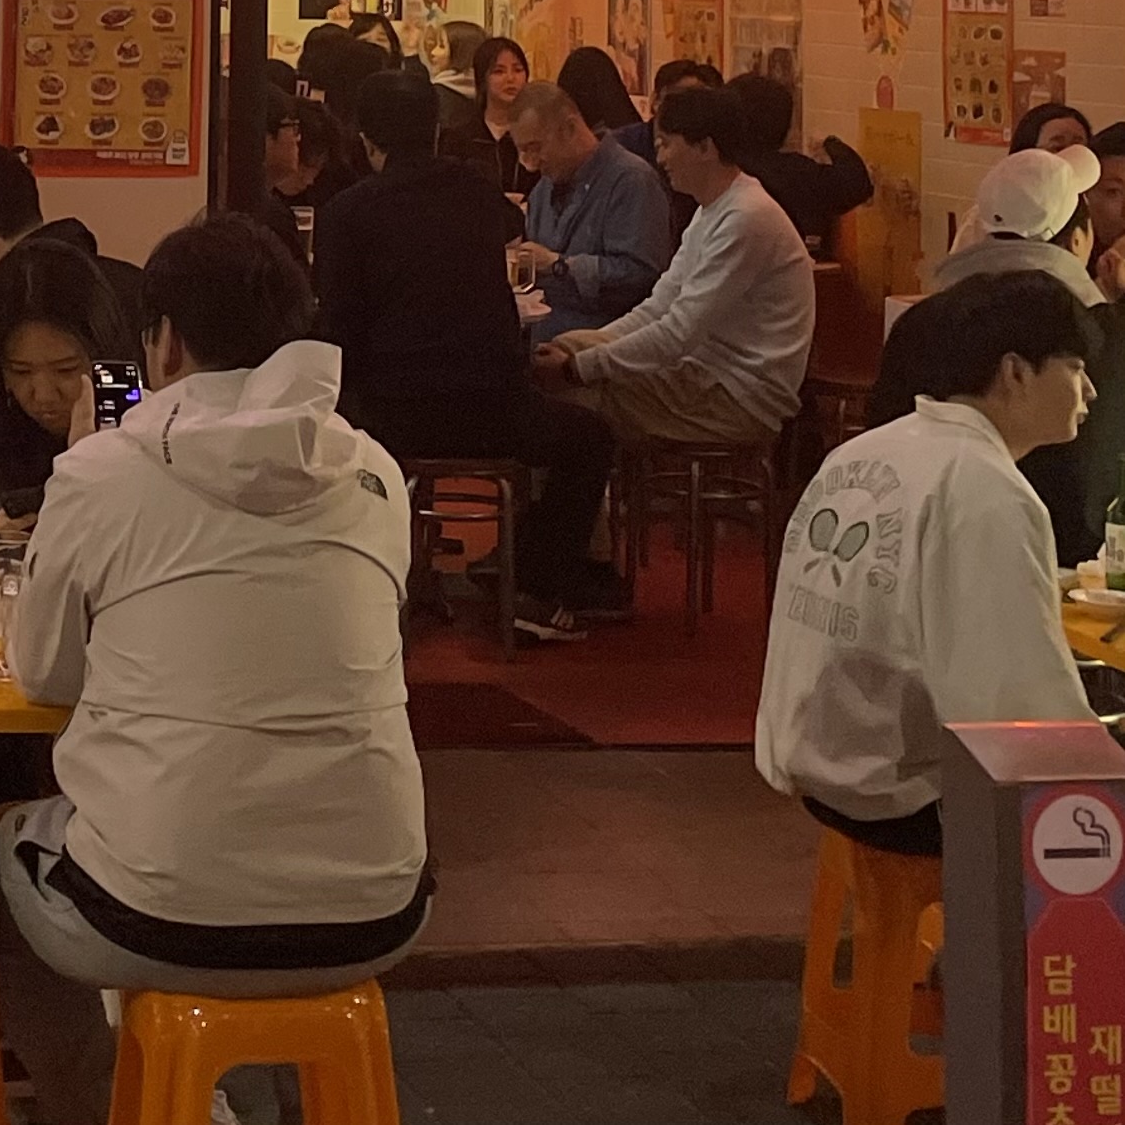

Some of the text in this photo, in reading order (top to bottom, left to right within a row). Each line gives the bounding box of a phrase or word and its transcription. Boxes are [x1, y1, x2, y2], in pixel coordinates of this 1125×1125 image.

[867, 507, 904, 594] NYC
[787, 585, 860, 642] ENNIS
[1088, 1026, 1122, 1125] 재떨
